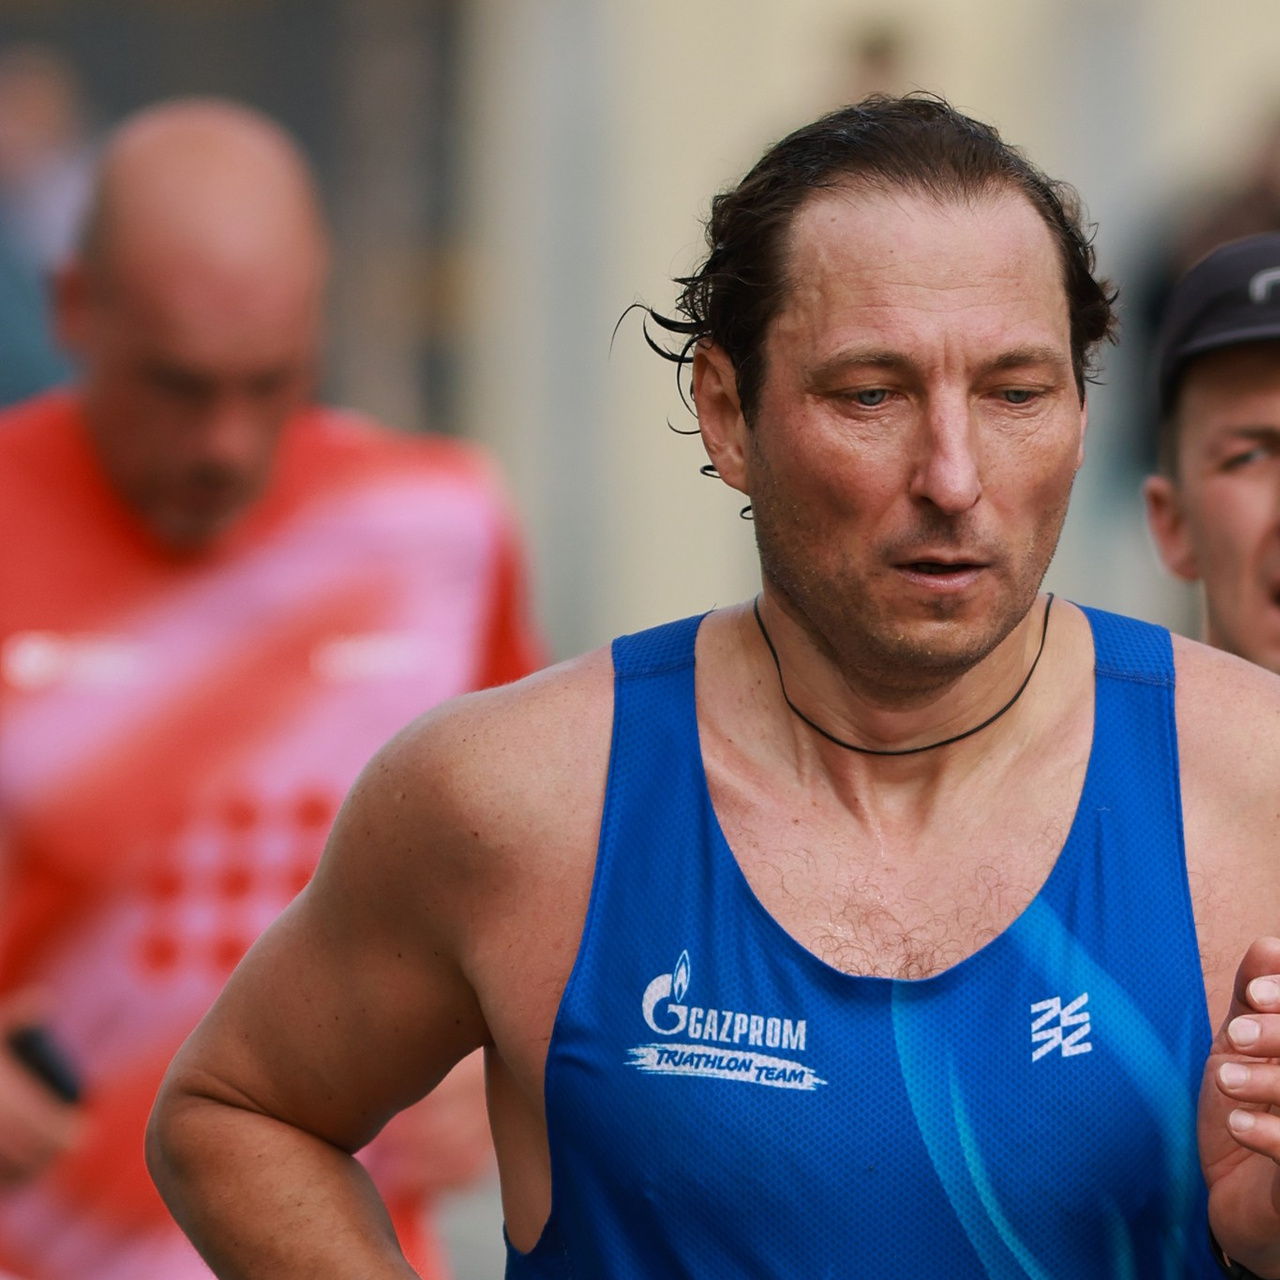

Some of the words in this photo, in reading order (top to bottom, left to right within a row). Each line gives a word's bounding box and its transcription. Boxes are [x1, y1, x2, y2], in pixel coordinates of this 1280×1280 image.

[688, 1007, 807, 1051] GAZPROM
[656, 1050, 754, 1072] TRIATHLON
[754, 1066, 806, 1083] TEAM
